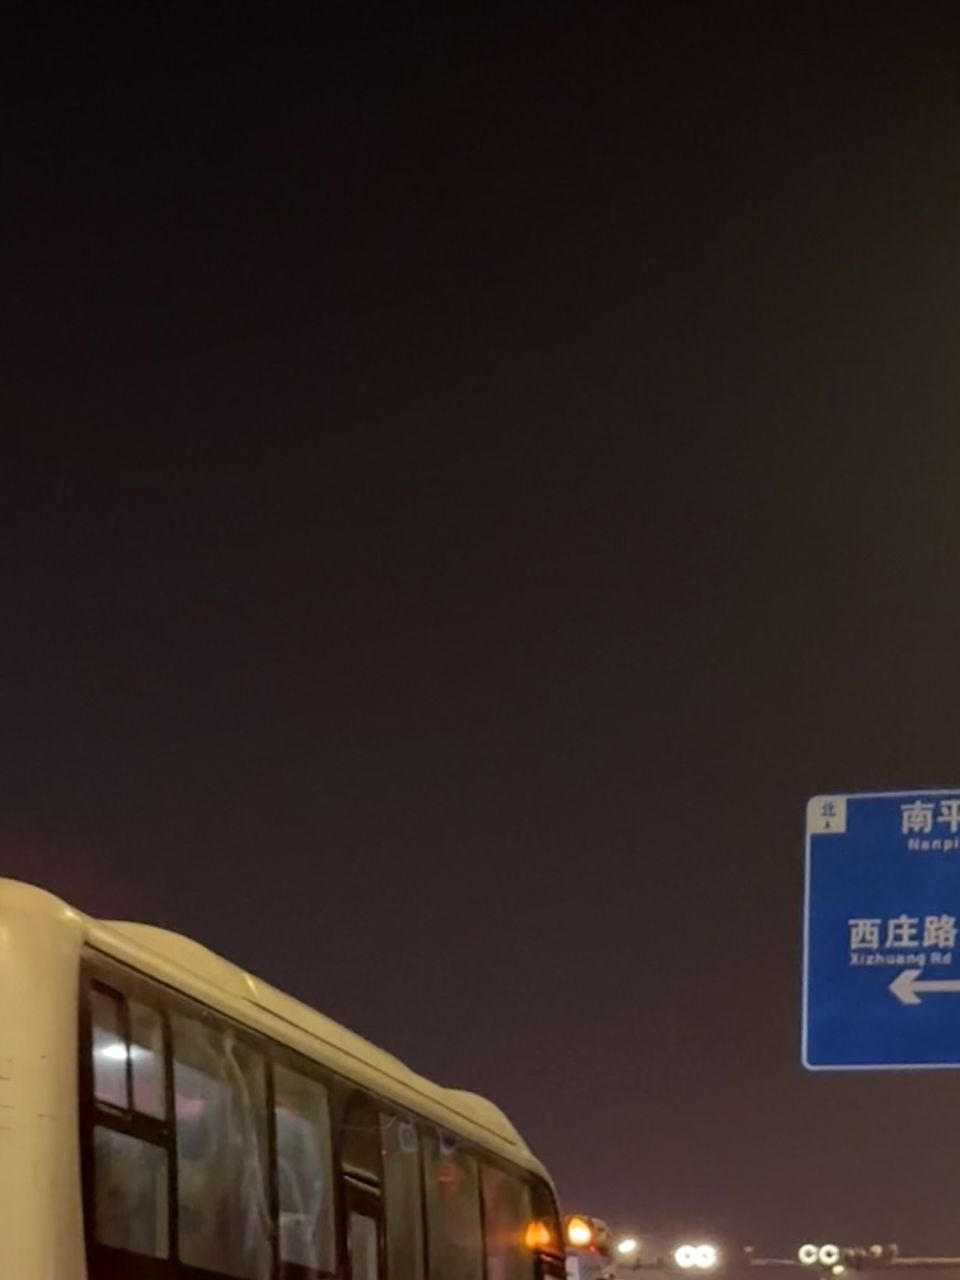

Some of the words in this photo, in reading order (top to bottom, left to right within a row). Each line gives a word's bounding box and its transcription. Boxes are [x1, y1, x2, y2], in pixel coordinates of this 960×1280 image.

[900, 799, 960, 834] 南平
[848, 914, 958, 950] 西庄路
[849, 952, 926, 967] Xizhuang
[929, 951, 952, 965] Rd
